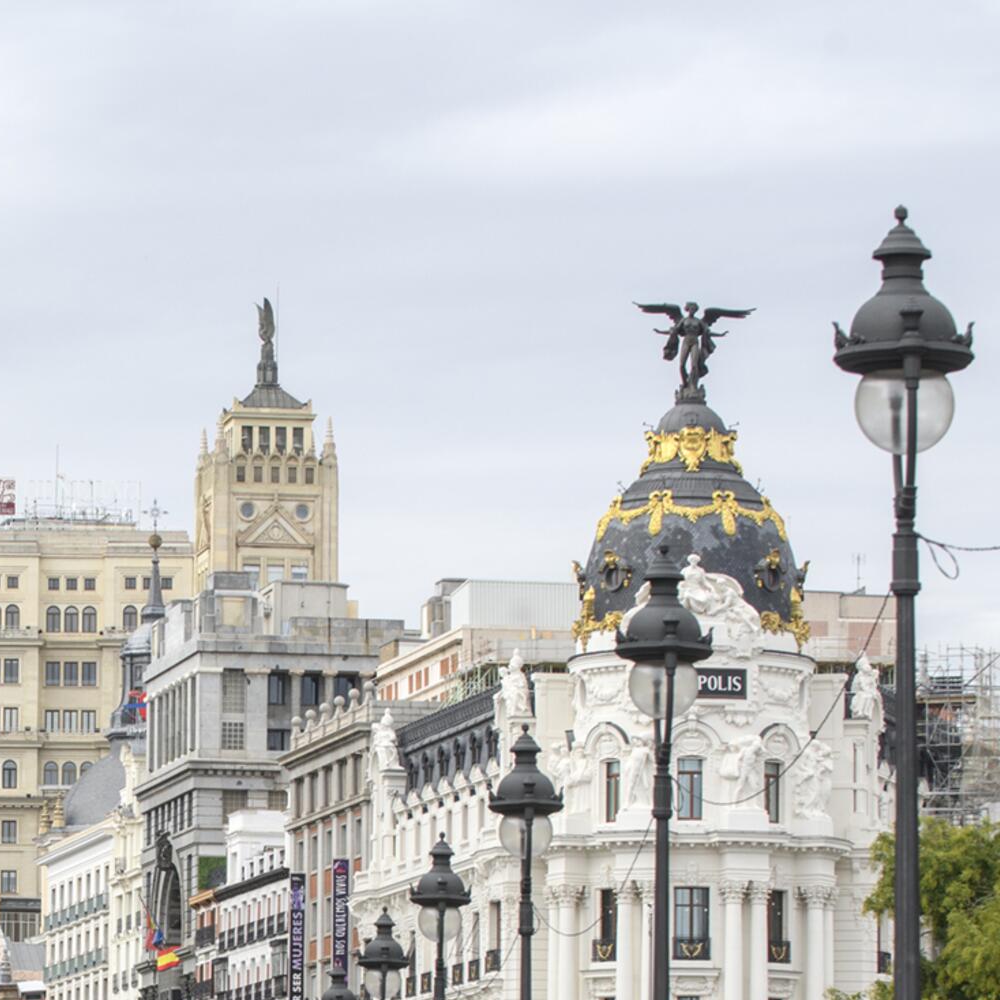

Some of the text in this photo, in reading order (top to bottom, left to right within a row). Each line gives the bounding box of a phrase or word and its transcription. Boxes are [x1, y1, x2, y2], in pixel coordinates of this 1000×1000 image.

[697, 674, 742, 692] POLIS
[291, 911, 303, 971] MUJERES
[292, 973, 302, 992] SER
